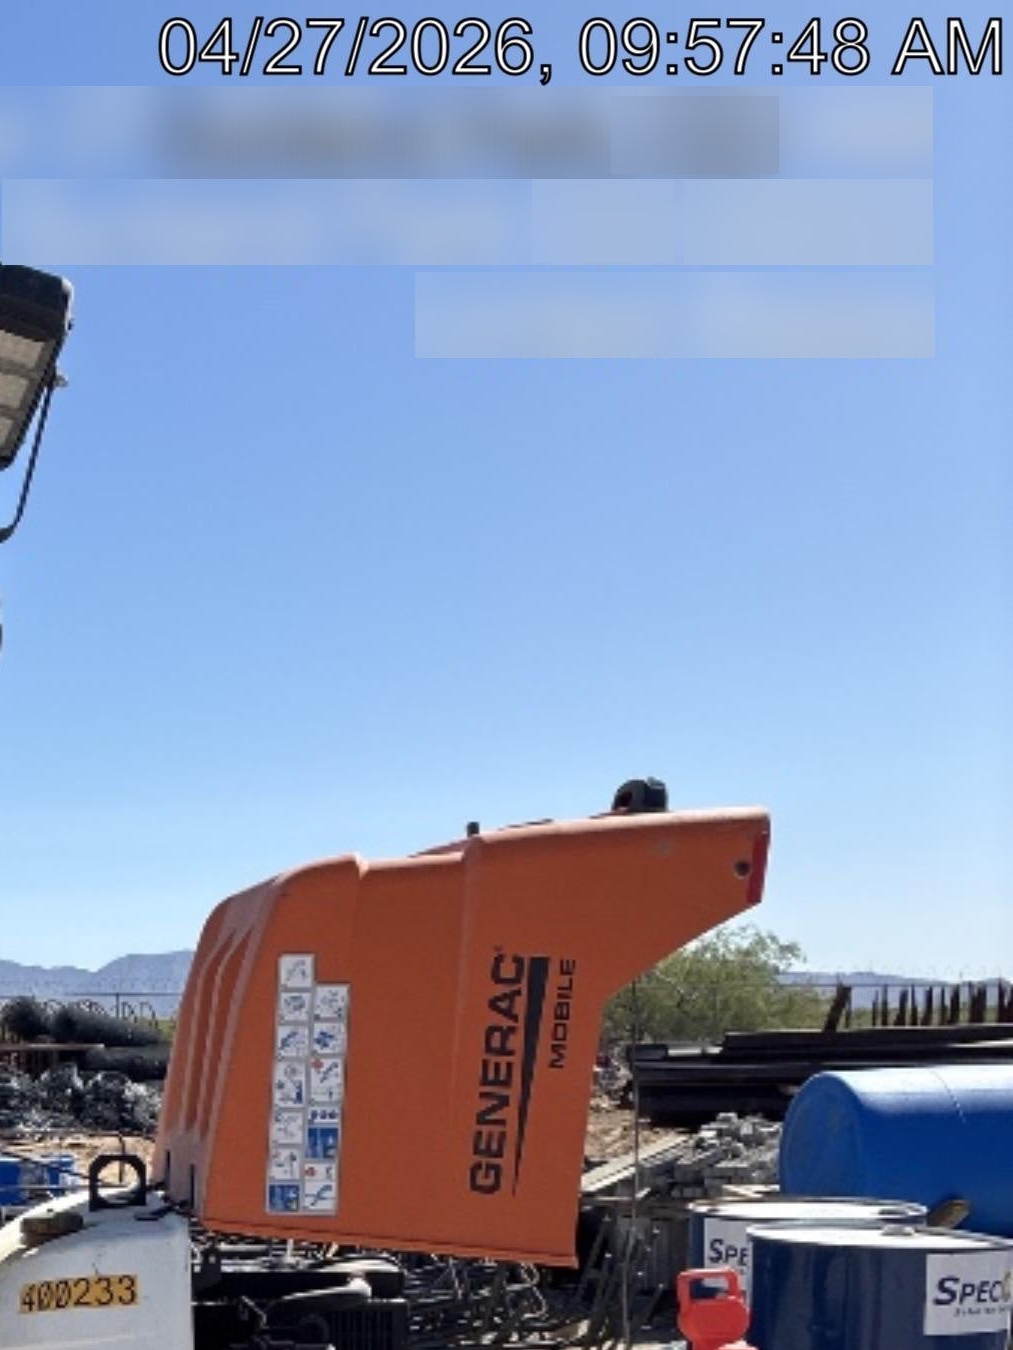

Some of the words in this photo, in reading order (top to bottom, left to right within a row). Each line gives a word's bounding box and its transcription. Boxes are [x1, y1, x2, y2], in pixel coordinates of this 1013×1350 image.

[548, 958, 576, 1069] MOBILE
[469, 953, 526, 1195] GENERAC
[20, 1274, 137, 1313] 400233
